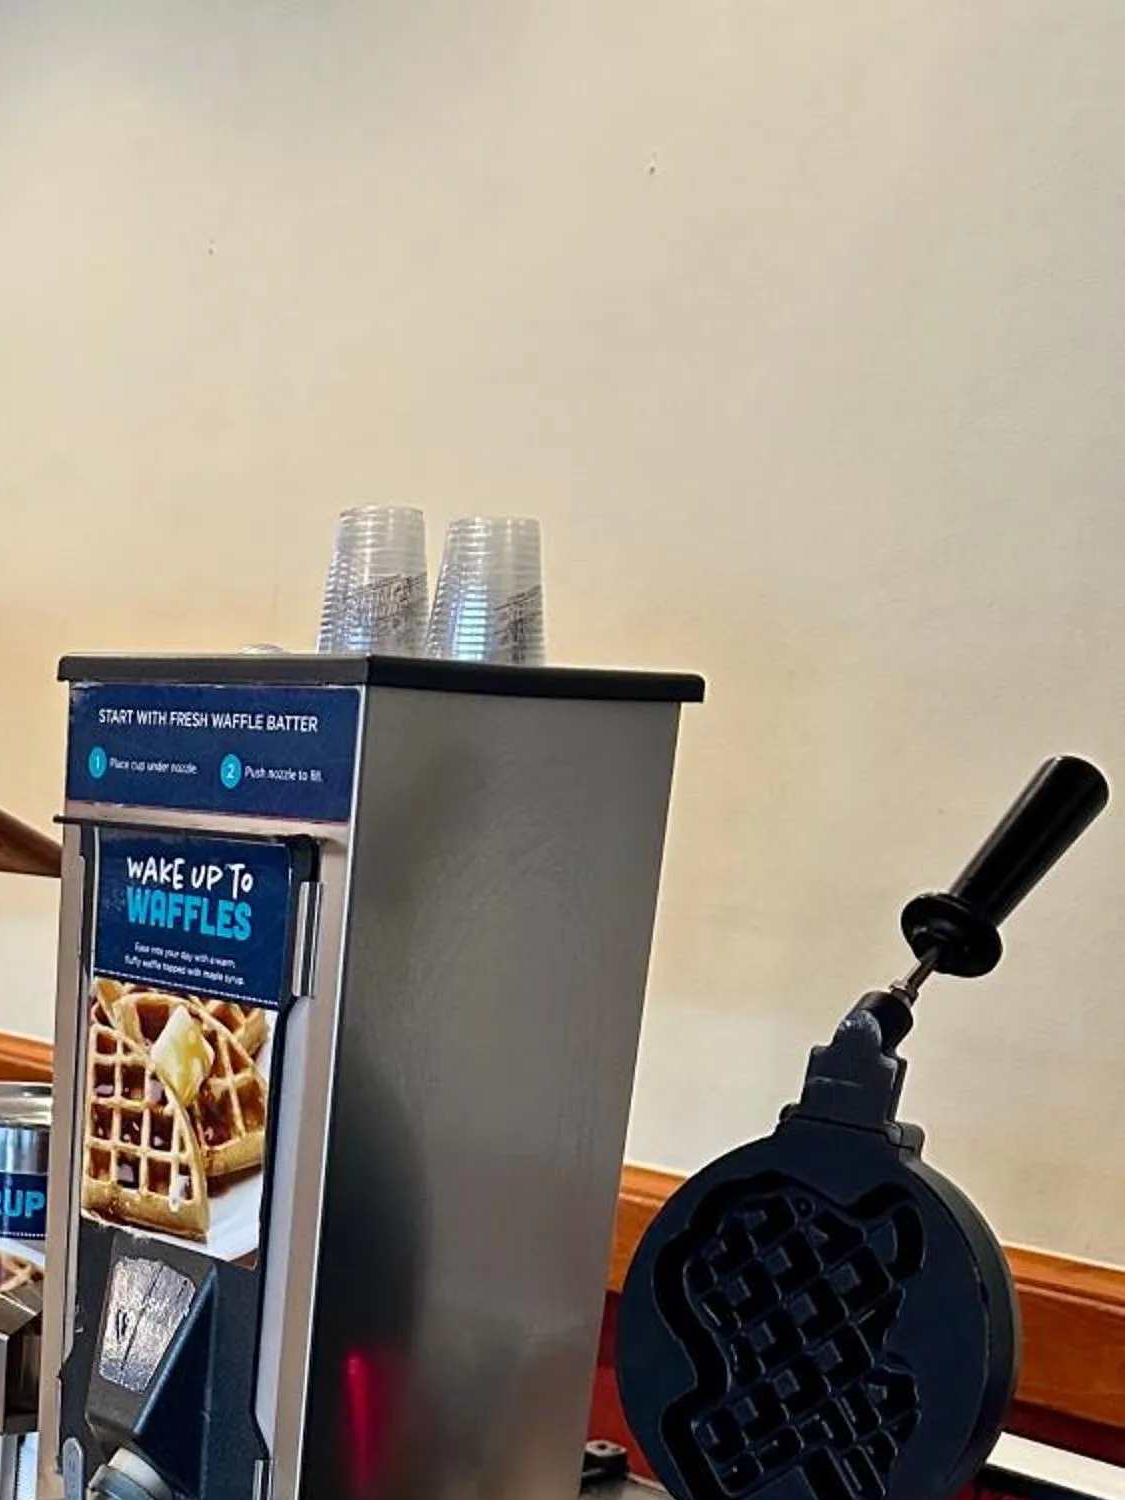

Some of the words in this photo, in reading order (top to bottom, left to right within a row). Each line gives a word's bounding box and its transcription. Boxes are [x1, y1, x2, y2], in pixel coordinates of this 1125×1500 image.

[98, 708, 134, 724] START
[136, 710, 166, 726] WITH
[169, 711, 208, 728] FRESH
[211, 712, 264, 730] WAFFLE
[266, 715, 318, 733] BATTER
[109, 757, 129, 769] Place
[226, 763, 236, 779] 2
[244, 765, 266, 779] Push
[267, 767, 296, 781] nozzle
[298, 769, 308, 782] to
[126, 855, 186, 891] WAKE
[191, 864, 224, 892] UP
[126, 885, 252, 942] WAFFLES
